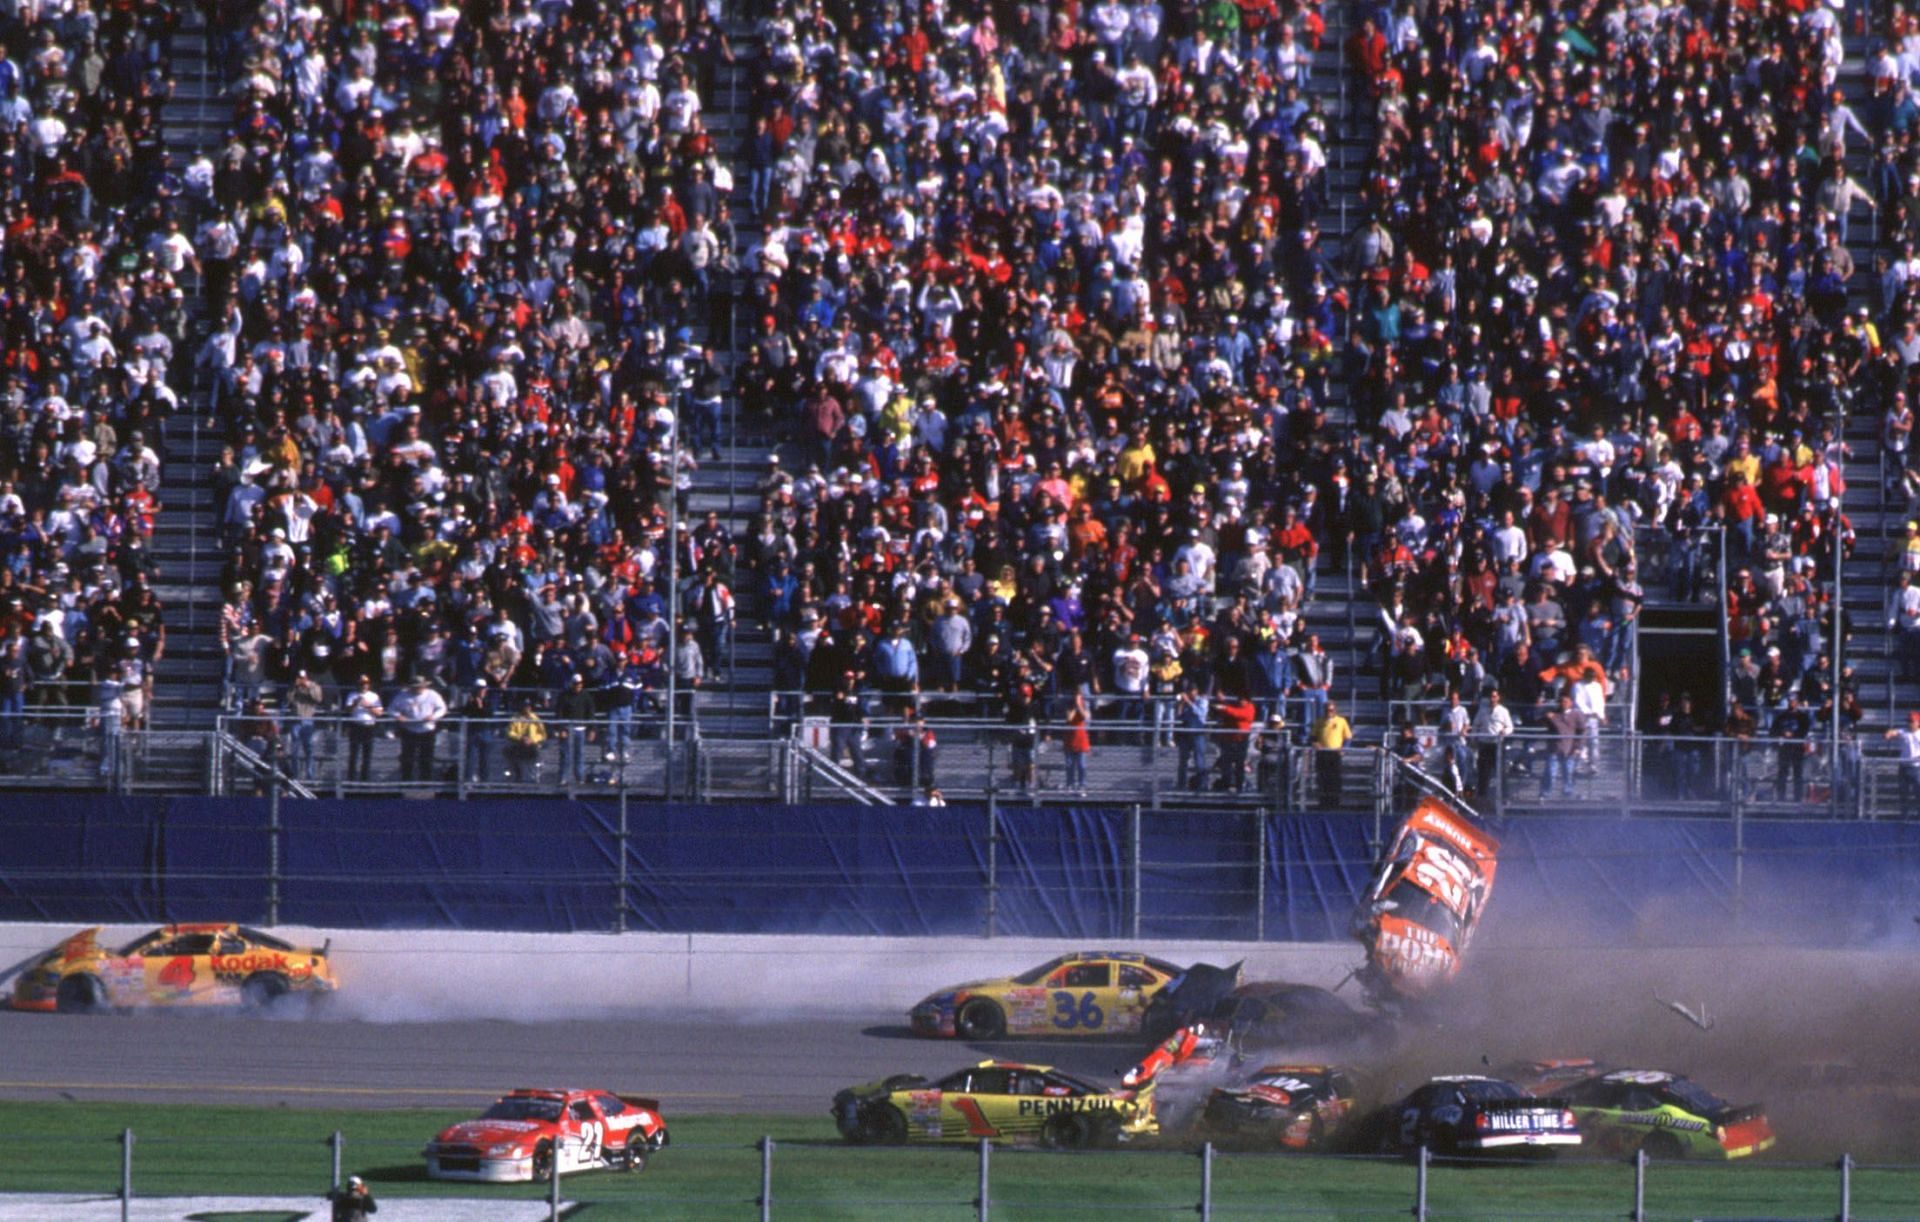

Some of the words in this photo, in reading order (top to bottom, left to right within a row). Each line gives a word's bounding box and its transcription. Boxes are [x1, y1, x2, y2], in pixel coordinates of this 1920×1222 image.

[157, 956, 195, 990] 4
[210, 954, 288, 972] Kodak
[1053, 991, 1104, 1029] 36
[951, 1097, 1000, 1137] 1
[1492, 1114, 1529, 1129] MILLER
[1533, 1113, 1560, 1128] TIME
[578, 1121, 603, 1163] 21
